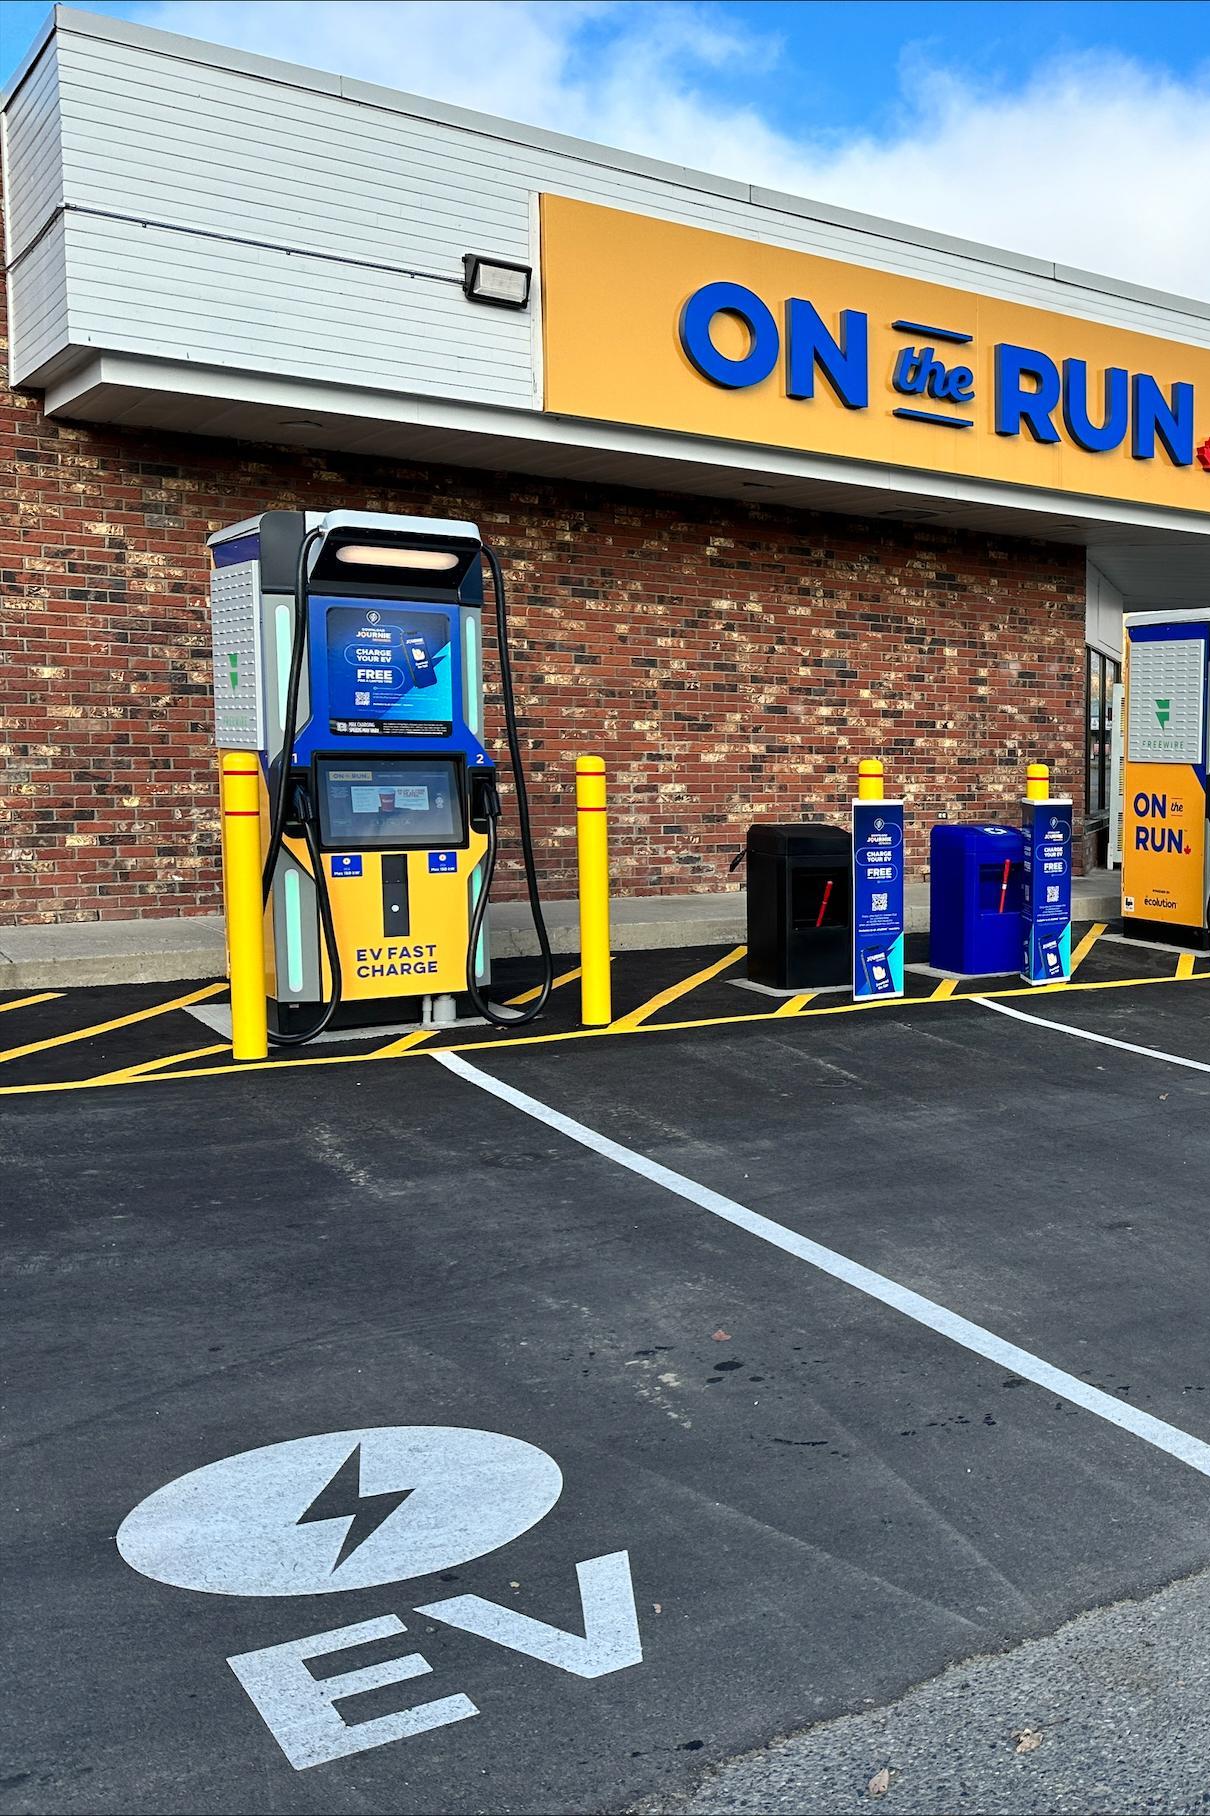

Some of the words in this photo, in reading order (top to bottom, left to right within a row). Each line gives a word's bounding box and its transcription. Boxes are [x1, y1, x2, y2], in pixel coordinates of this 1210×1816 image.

[678, 281, 869, 410] ON
[892, 345, 976, 403] the
[356, 631, 392, 639] JOURNIE
[355, 648, 392, 656] CHARGE
[357, 669, 393, 680] FREE
[1142, 740, 1184, 749] FREEWIRE
[476, 753, 485, 764] 2
[1133, 792, 1167, 819] ON
[1170, 802, 1184, 812] the
[1044, 862, 1063, 871] FREE
[867, 868, 892, 877] FREE
[1144, 896, 1177, 909] écolution
[356, 948, 383, 961] EV
[388, 945, 437, 959] FAST
[356, 961, 438, 978] CHARGE
[226, 1549, 644, 1771] EV
